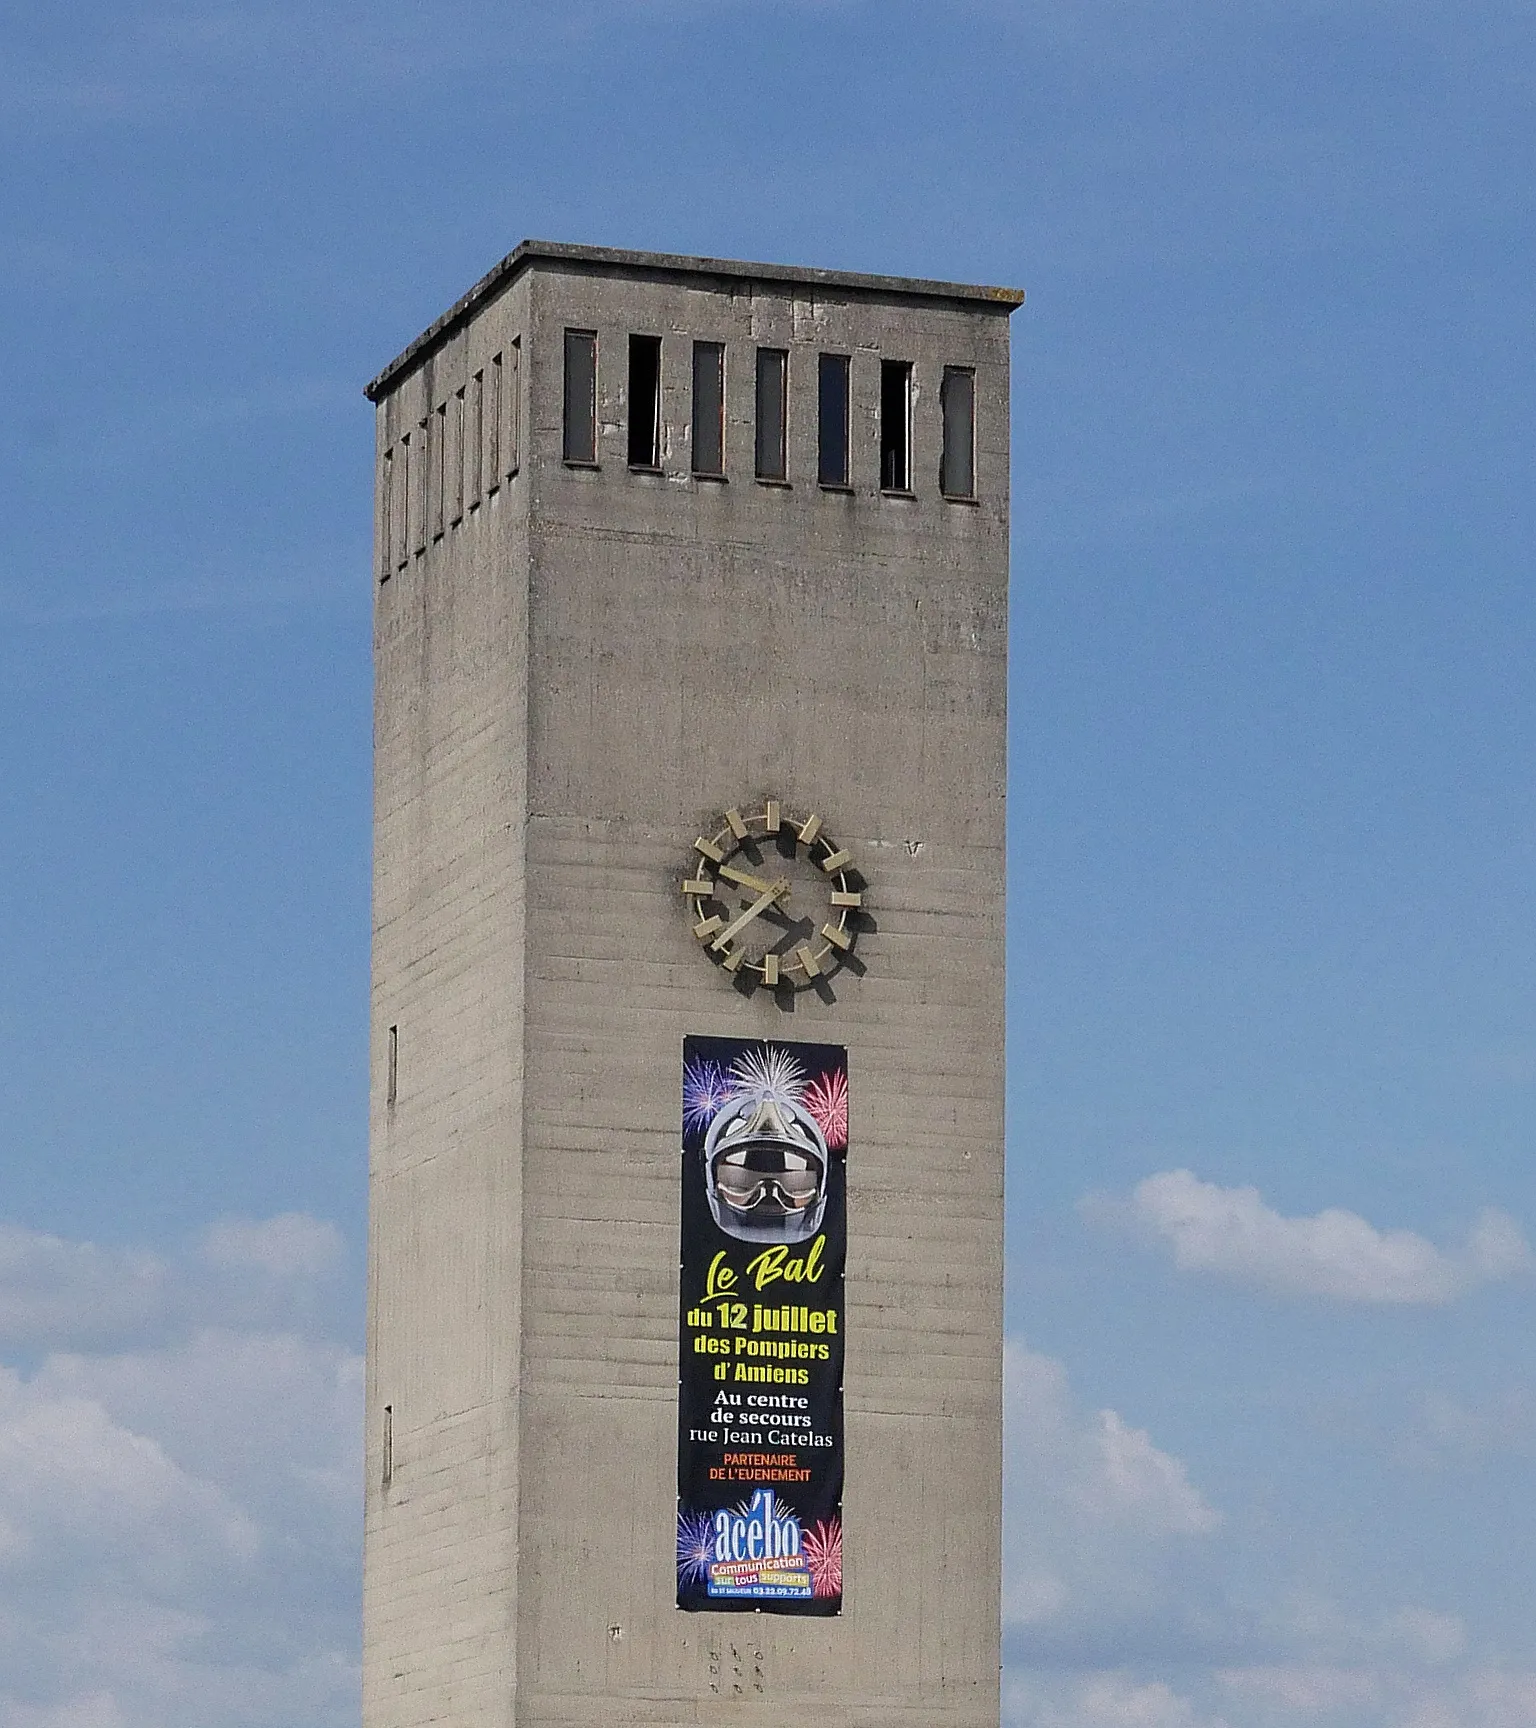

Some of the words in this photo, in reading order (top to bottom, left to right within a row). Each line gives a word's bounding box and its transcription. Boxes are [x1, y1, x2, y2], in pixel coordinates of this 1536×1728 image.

[746, 1234, 826, 1291] Bal
[687, 1308, 712, 1327] du
[716, 1302, 748, 1329] 12
[752, 1304, 838, 1334] juillet
[694, 1335, 730, 1355] des
[735, 1337, 830, 1360] Pompiers
[714, 1389, 742, 1405] Au
[746, 1394, 809, 1409] centre
[710, 1407, 734, 1423] de
[739, 1412, 812, 1427] secours
[689, 1429, 718, 1442] rue
[724, 1428, 762, 1445] Jean
[768, 1429, 833, 1447] Catelas
[724, 1453, 797, 1466] PARTENAIRE
[709, 1468, 725, 1480] DE
[728, 1468, 812, 1482] L'EVENEMENT
[711, 1557, 803, 1576] Communication
[735, 1574, 758, 1586] tous
